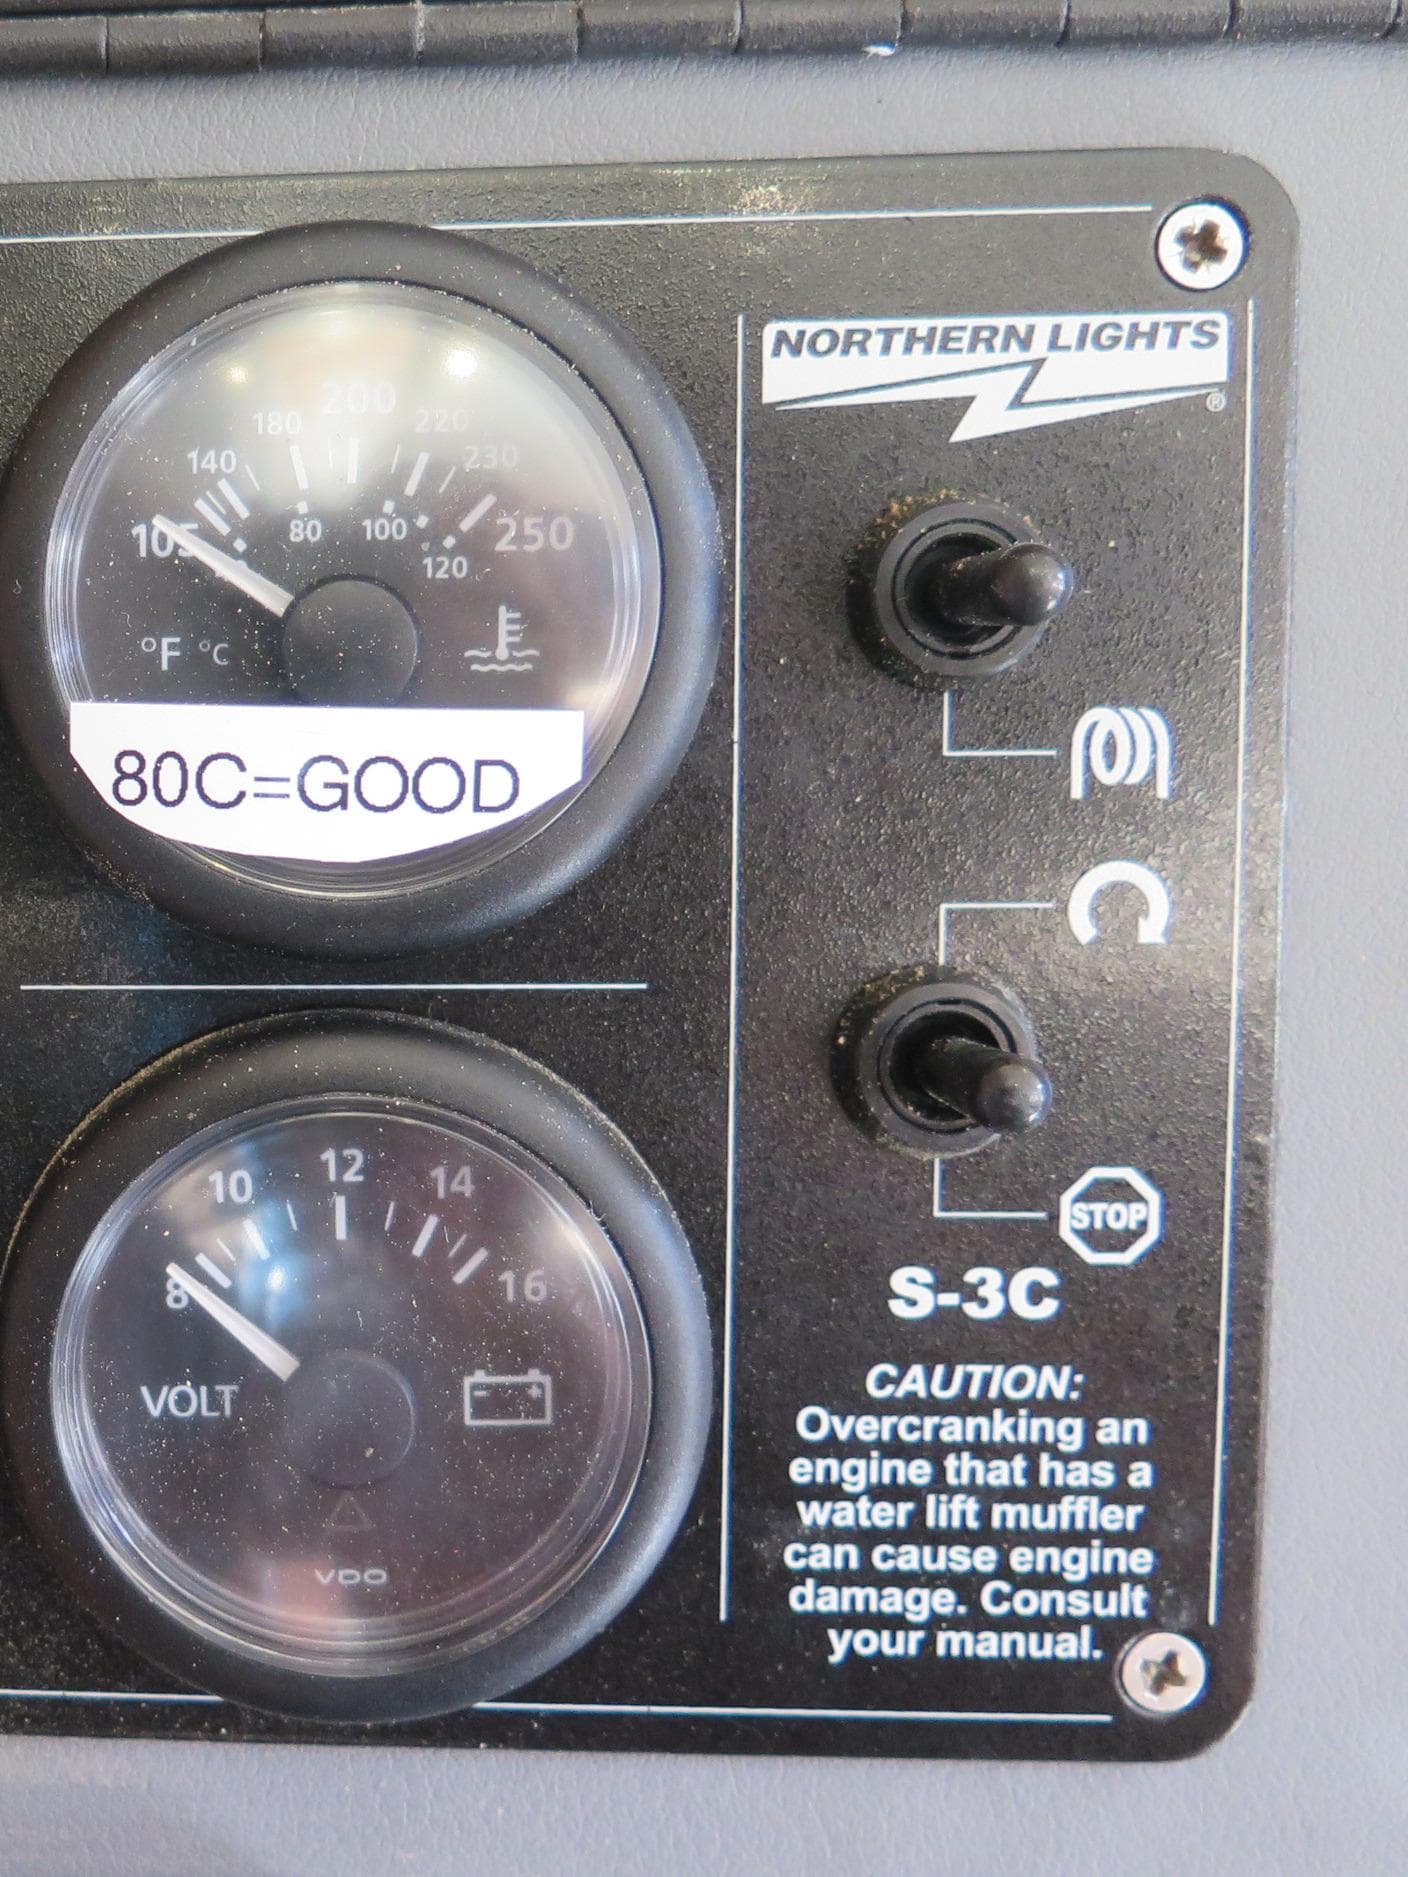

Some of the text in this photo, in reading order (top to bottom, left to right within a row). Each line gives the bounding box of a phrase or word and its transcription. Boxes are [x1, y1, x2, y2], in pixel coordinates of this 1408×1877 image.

[770, 318, 1222, 359] NORTHERN LIGHTS
[320, 382, 397, 416] 200
[252, 410, 303, 436] 180
[414, 408, 470, 434] 220
[187, 449, 237, 476] 140
[462, 445, 520, 470] 230
[289, 519, 323, 543] 80
[362, 518, 408, 542] 100
[494, 515, 575, 552] 250
[423, 556, 468, 580] 120
[111, 748, 522, 815] 80C=GOOD
[319, 1148, 365, 1183] 12
[430, 1165, 475, 1199] 14
[208, 1169, 253, 1204] 10
[1069, 1202, 1150, 1231] STOP
[165, 1272, 190, 1310] 8
[498, 1269, 548, 1303] 16
[887, 1265, 1062, 1321] S-3C
[865, 1363, 1086, 1401] CAUTION:
[140, 1384, 240, 1419] VOLT
[795, 1405, 1151, 1452] Overcranking an
[788, 1450, 1154, 1494] engine that has a
[796, 1495, 1145, 1534] water lift muffler
[314, 1568, 389, 1586] VDO
[783, 1540, 1155, 1582] can cause engine
[788, 1578, 1151, 1623] damage. Consult
[826, 1624, 1104, 1666] your manual.
